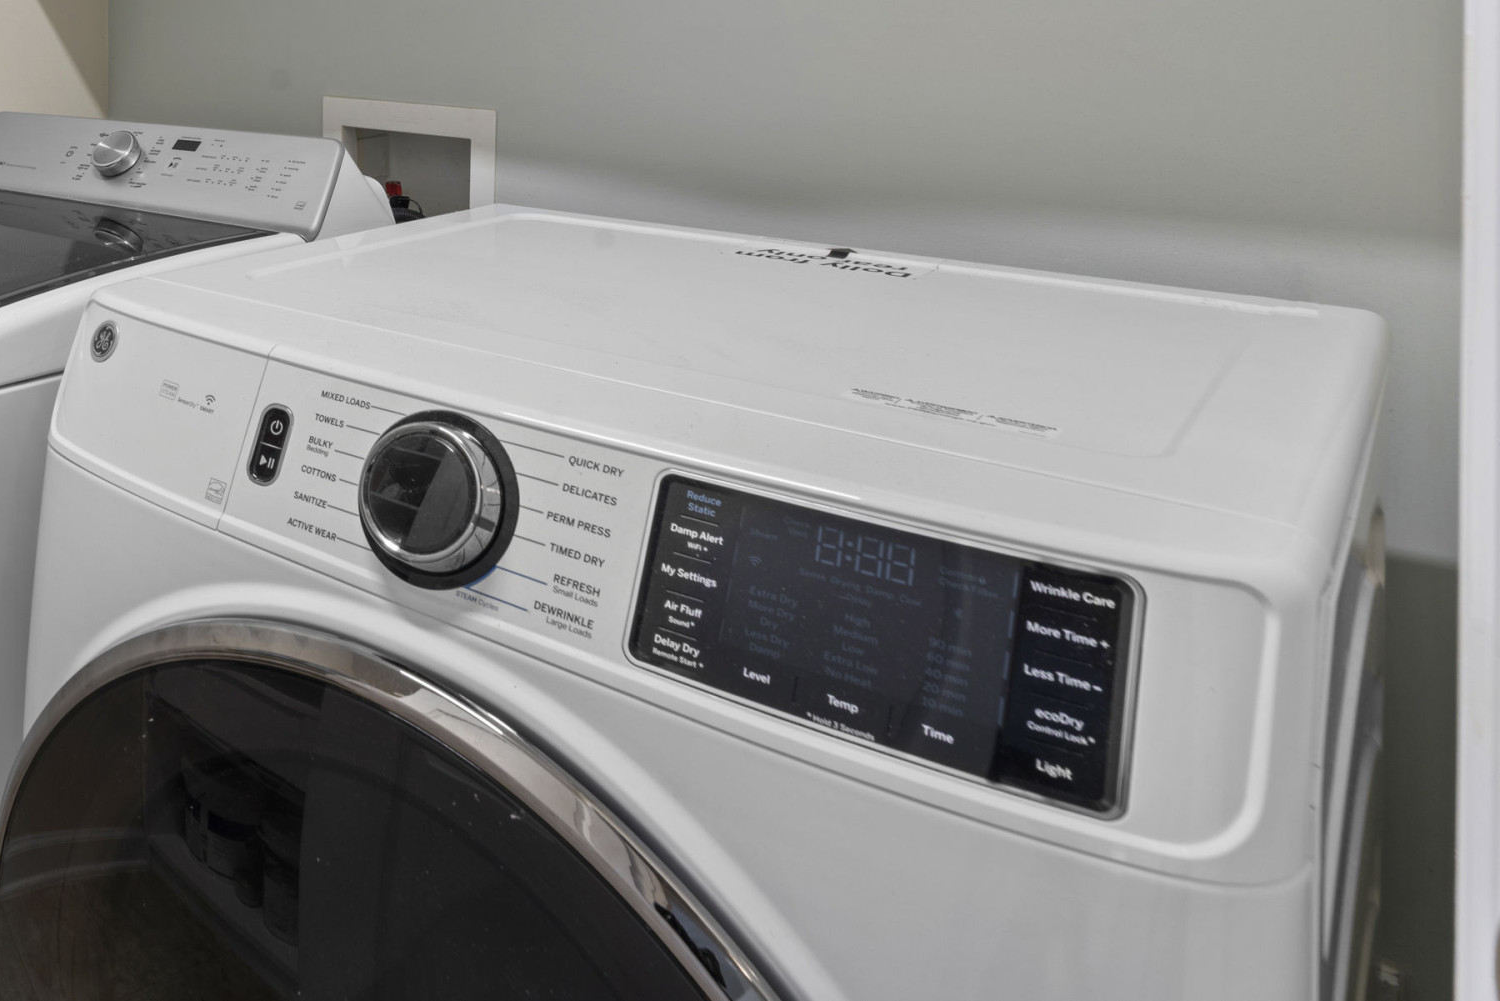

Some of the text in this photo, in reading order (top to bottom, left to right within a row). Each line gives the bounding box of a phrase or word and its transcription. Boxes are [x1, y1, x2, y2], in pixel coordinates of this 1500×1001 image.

[735, 251, 911, 278] Dolly from
[756, 249, 906, 271] rear only
[199, 405, 215, 415] SMART
[321, 390, 371, 410] MIXED LOADS
[314, 413, 345, 428] TOWELS
[306, 443, 329, 457] Bedding
[308, 435, 334, 450] BULKY
[300, 464, 337, 482] COTTONS
[568, 455, 625, 478] QUICK DRY
[293, 491, 328, 509] SANITIZE
[562, 483, 618, 506] DELICATES
[687, 490, 722, 507] Reduce
[687, 502, 716, 517] Static
[287, 517, 337, 542] ACTIVE WEAR
[546, 511, 611, 538] PERM PRESS
[670, 522, 724, 546] Damp Alert
[550, 542, 606, 568] TIMED DRY
[553, 574, 601, 598] REFRESH
[661, 563, 717, 588] My Settings
[455, 590, 477, 603] STEAM
[552, 585, 599, 608] Small Loads
[779, 593, 797, 609] Dry
[1030, 580, 1116, 609] Wrinkle Care
[533, 600, 594, 630] DEWRINKLE
[664, 599, 703, 619] Air Fluff
[777, 607, 796, 622] Dry
[546, 616, 593, 639] Large Loads
[760, 616, 779, 630] Dry
[1026, 620, 1062, 639] More
[1062, 628, 1098, 648] Time
[654, 633, 700, 658] Delay Dry
[833, 624, 879, 645] Medium
[652, 646, 698, 668] Remote Start
[743, 666, 771, 685] Level
[1023, 662, 1055, 682] Less
[1055, 671, 1091, 691] Time
[827, 693, 859, 715] Temp
[811, 714, 832, 727] Hold
[833, 720, 839, 730] 3
[1034, 708, 1085, 731] ecoDry
[921, 723, 955, 744] Time
[1026, 720, 1089, 746] Control Lock
[1035, 758, 1073, 781] Light
